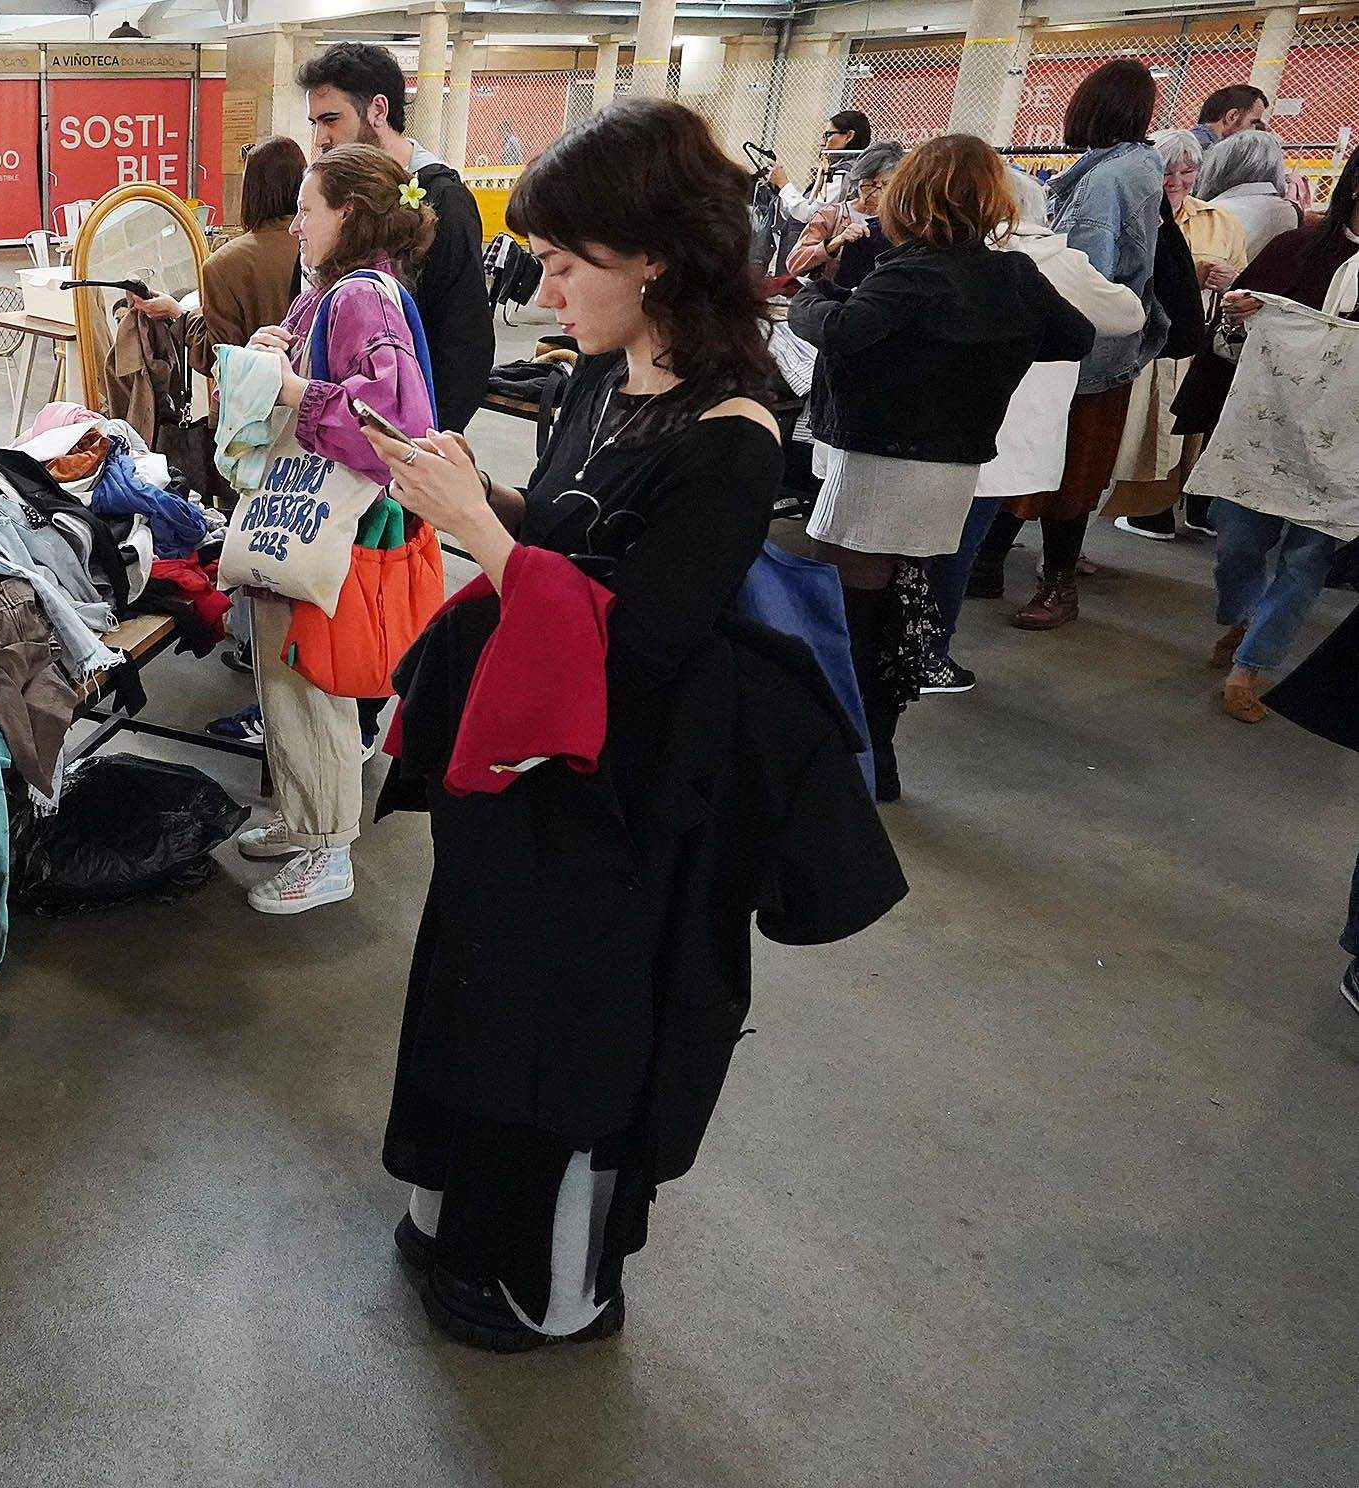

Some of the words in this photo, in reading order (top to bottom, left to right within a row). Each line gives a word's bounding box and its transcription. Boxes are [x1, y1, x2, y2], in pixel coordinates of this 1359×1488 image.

[52, 57, 61, 66] A
[62, 53, 120, 66] VIÑOTECA
[60, 115, 179, 149] SOSTI-
[117, 154, 178, 186] BLE
[241, 494, 330, 545] ABERTAS
[248, 530, 290, 561] 2025
